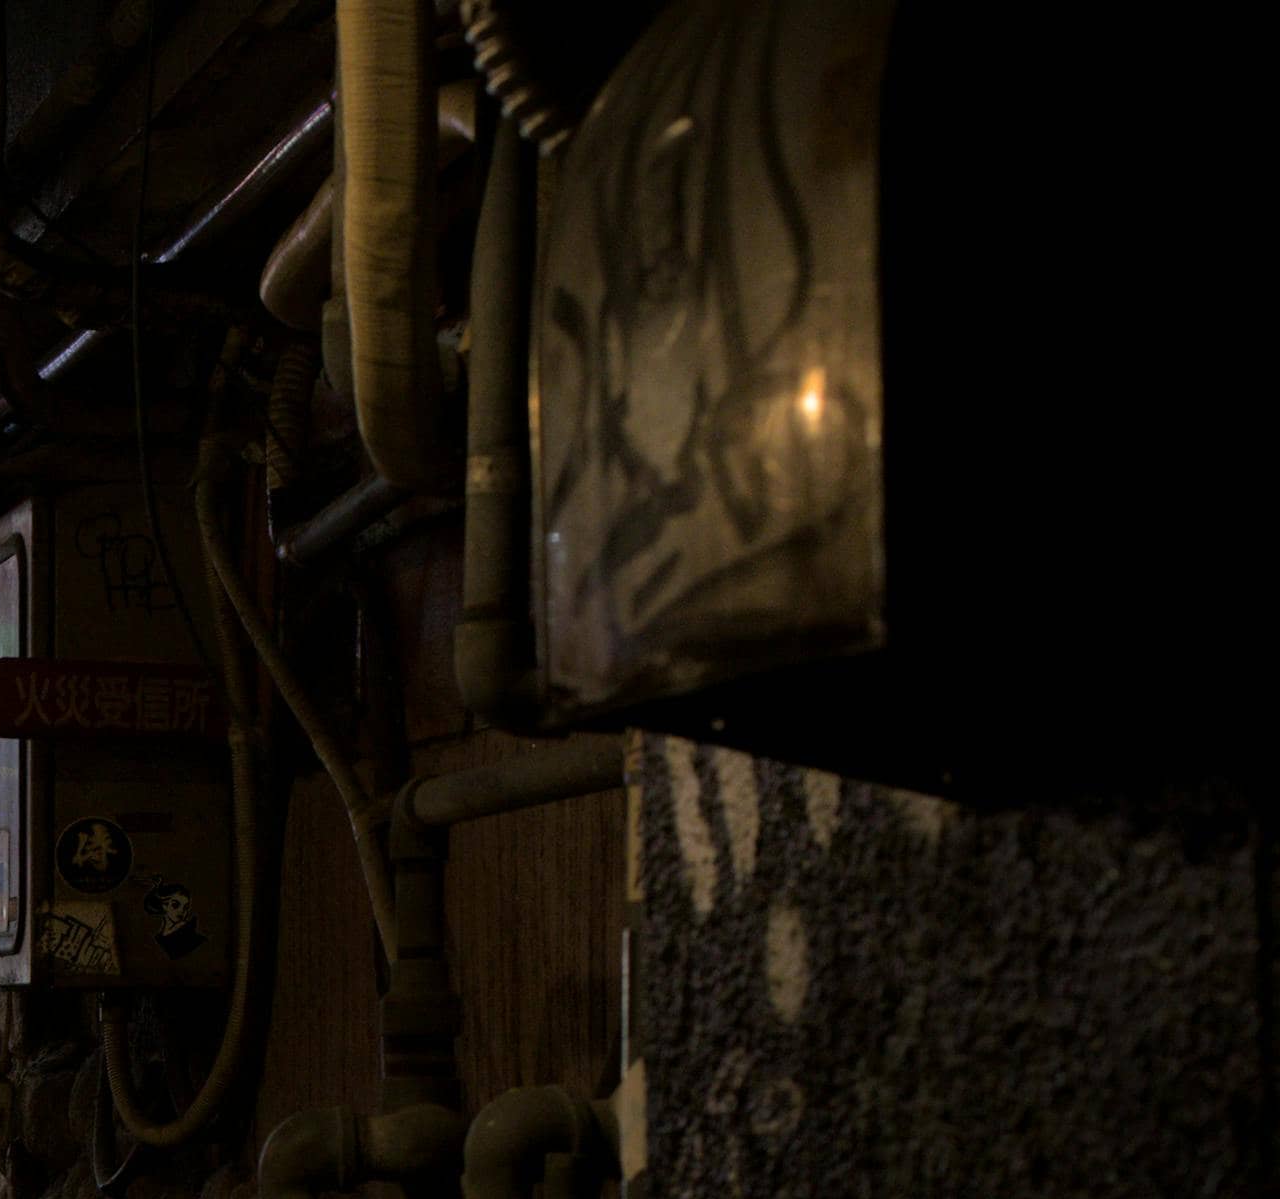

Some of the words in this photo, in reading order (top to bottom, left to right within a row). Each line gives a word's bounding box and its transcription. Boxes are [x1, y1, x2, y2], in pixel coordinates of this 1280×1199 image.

[14, 672, 211, 731] 火災受信所
